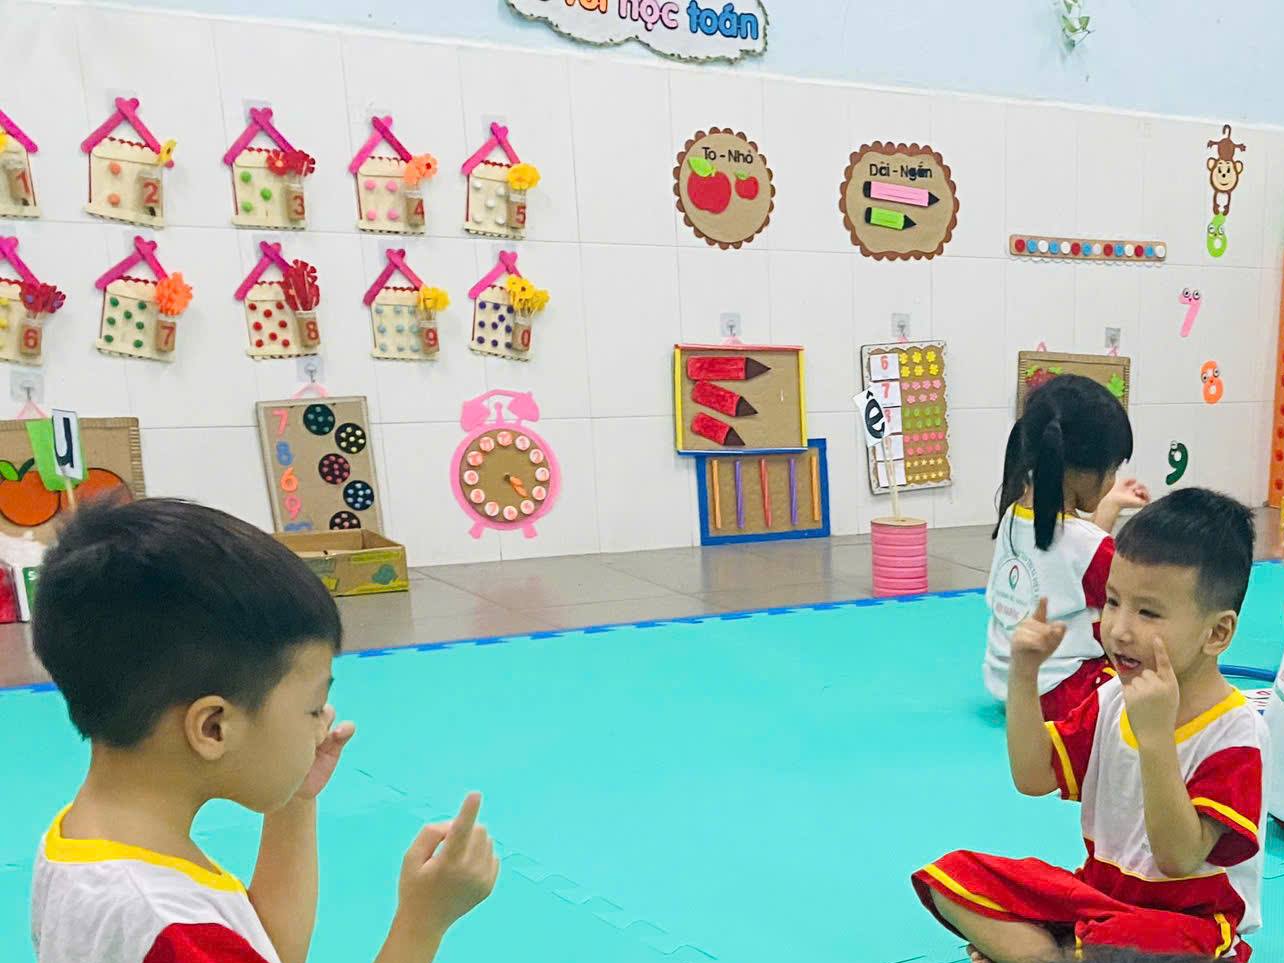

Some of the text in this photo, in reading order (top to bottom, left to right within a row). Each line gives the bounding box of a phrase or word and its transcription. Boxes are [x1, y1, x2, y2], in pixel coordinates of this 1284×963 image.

[687, 0, 760, 40] toán
[702, 147, 717, 161] To
[728, 148, 754, 164] Nhỏ
[869, 161, 890, 177] Dài
[16, 171, 31, 194] 1
[143, 182, 159, 204] 2
[293, 194, 305, 215] 3
[414, 200, 425, 218] 4
[515, 205, 526, 224] 5
[23, 328, 38, 349] 6
[160, 325, 175, 346] 7
[306, 320, 318, 341] 8
[425, 328, 437, 348] 9
[880, 356, 888, 370] 6
[881, 382, 890, 399] 7
[1200, 360, 1224, 405] 8
[272, 408, 289, 438] 7
[865, 390, 886, 439] ê
[276, 440, 293, 466] 8
[1165, 441, 1188, 486] 9
[281, 466, 298, 492] 6
[284, 494, 302, 521] 9
